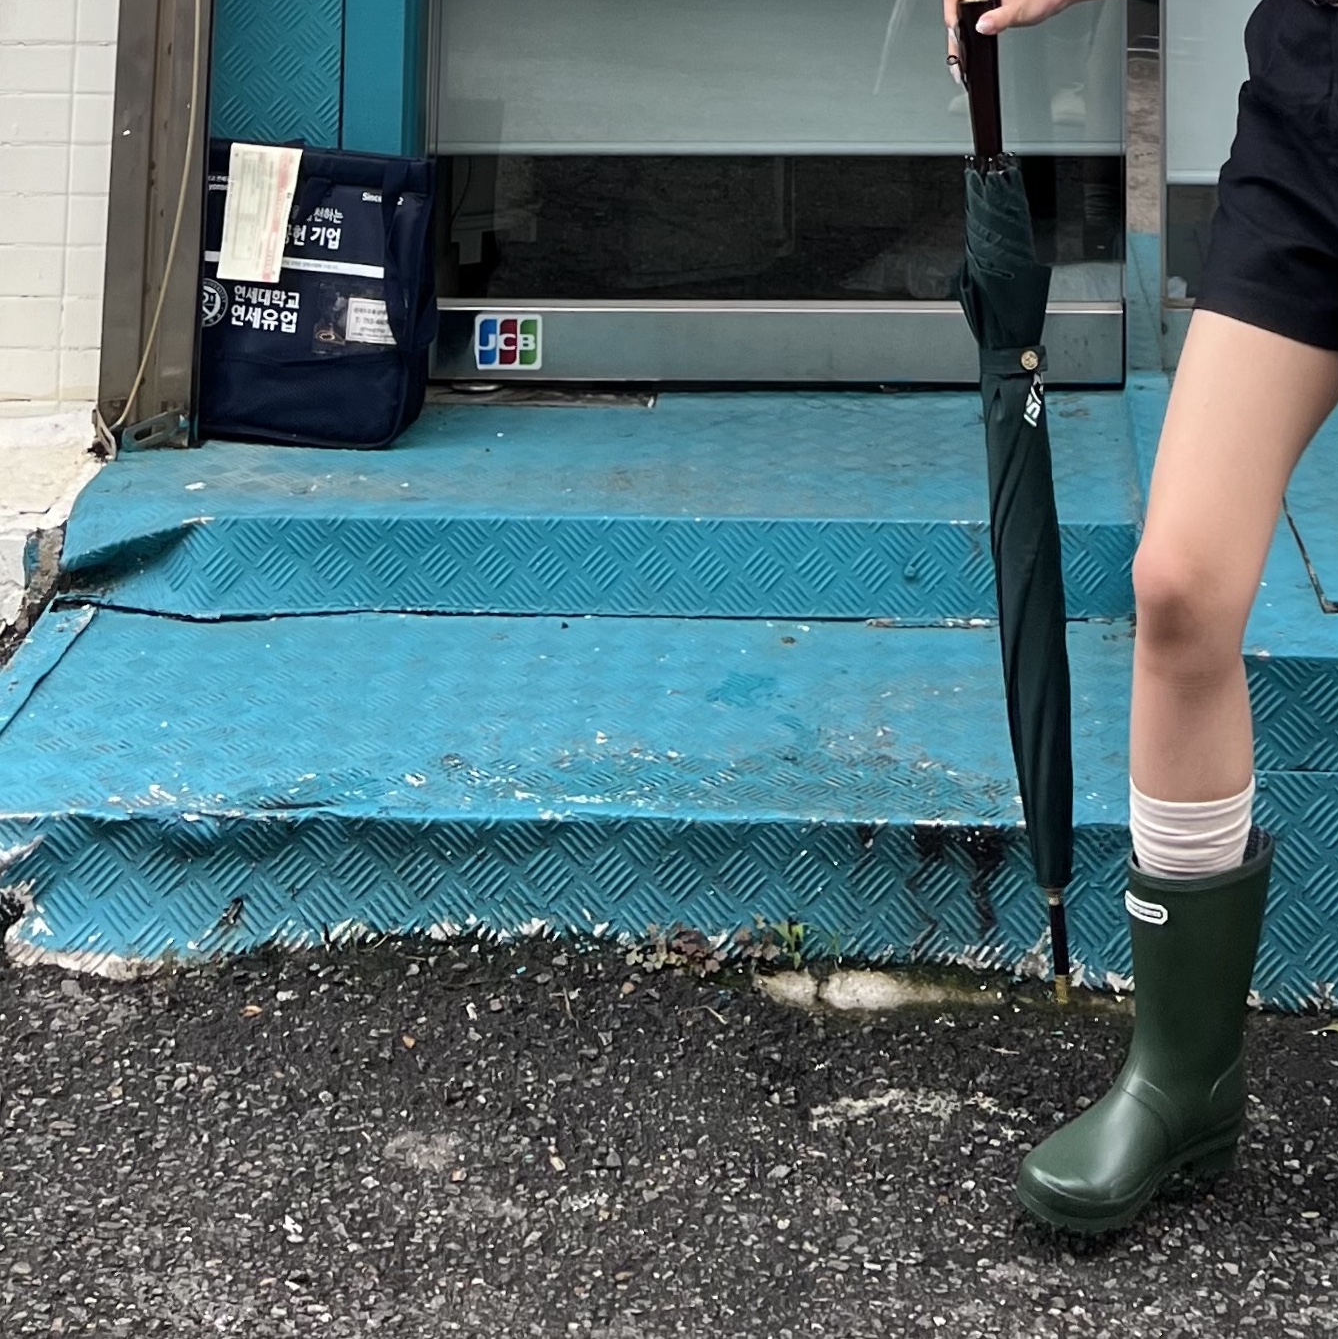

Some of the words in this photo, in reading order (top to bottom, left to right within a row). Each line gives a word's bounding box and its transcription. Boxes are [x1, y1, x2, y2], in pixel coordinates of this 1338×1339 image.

[310, 226, 342, 250] 기업
[233, 284, 300, 310] 연세대학교
[231, 304, 298, 334] 연세유업
[479, 333, 536, 351] JCB
